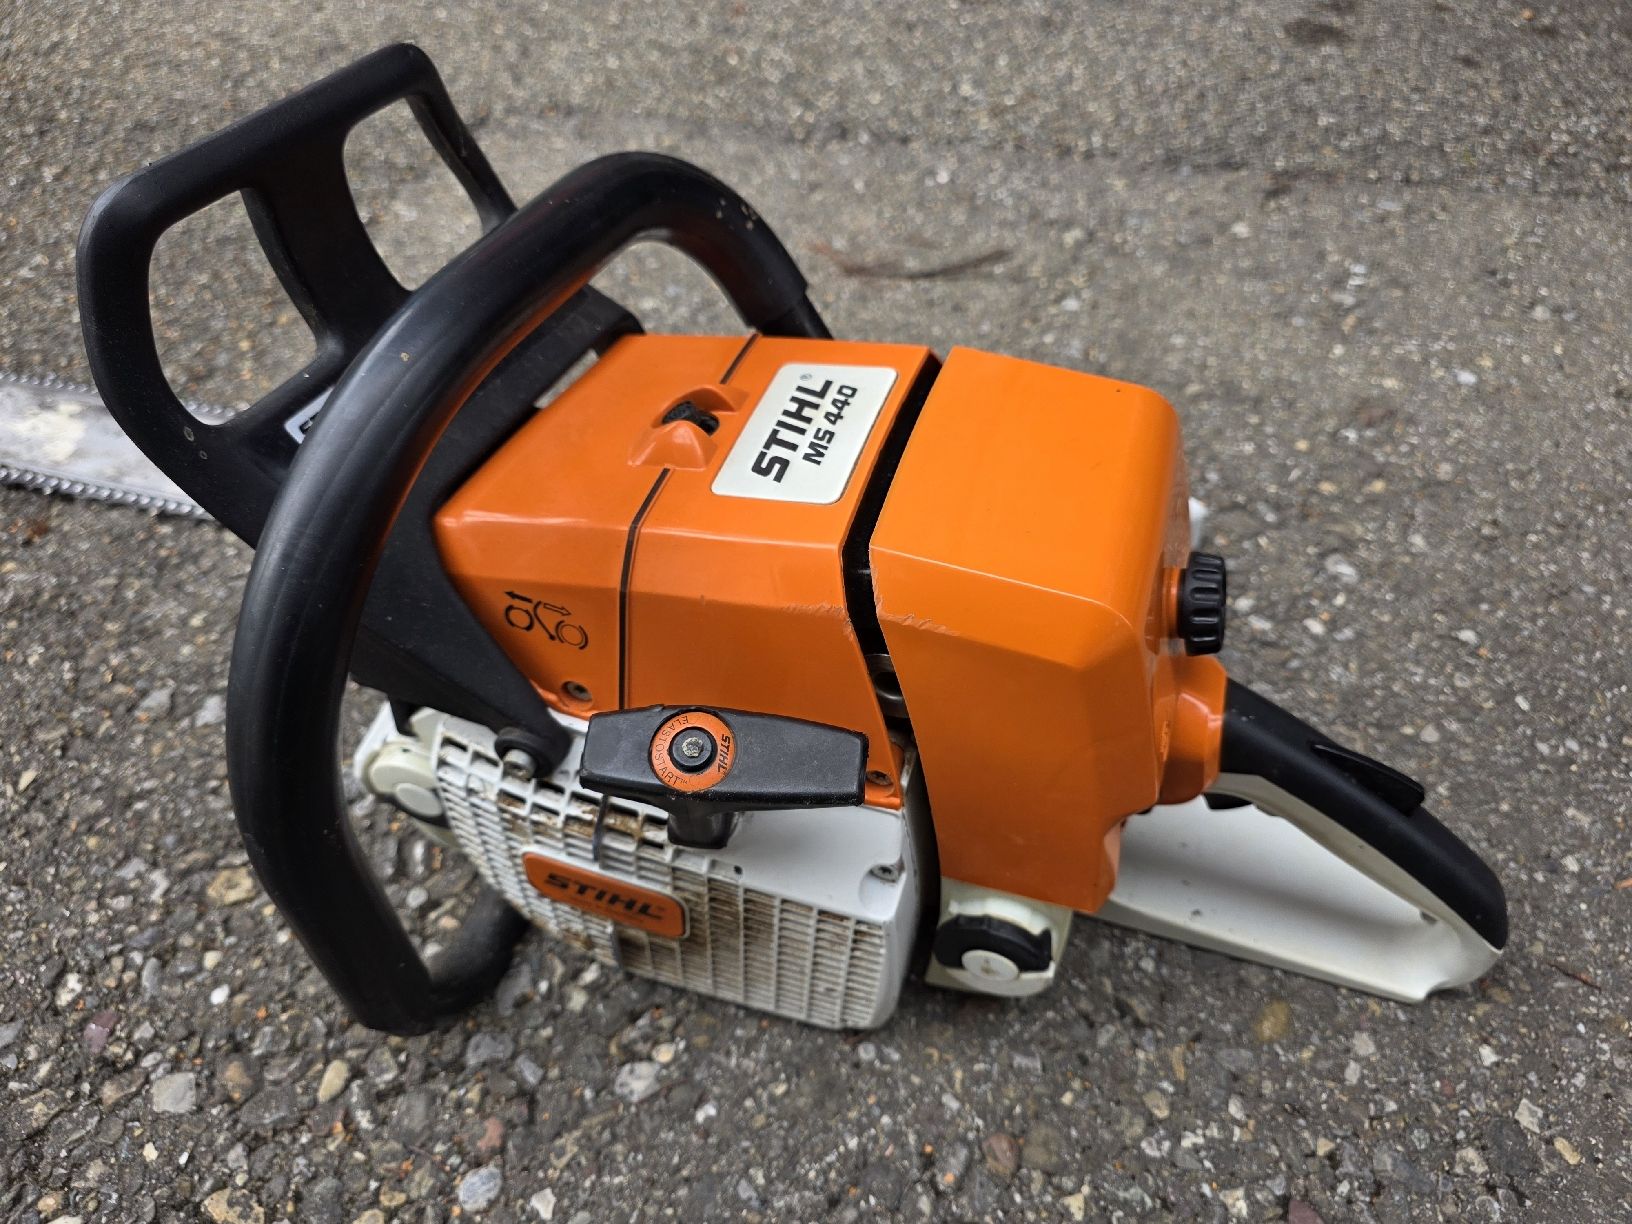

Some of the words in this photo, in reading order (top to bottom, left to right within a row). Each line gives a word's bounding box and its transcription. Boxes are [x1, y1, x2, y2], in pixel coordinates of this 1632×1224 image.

[751, 380, 834, 484] STIHL
[802, 427, 836, 466] MS
[823, 384, 858, 426] 440
[717, 733, 731, 773] STIHL
[544, 872, 663, 920] STIHL
